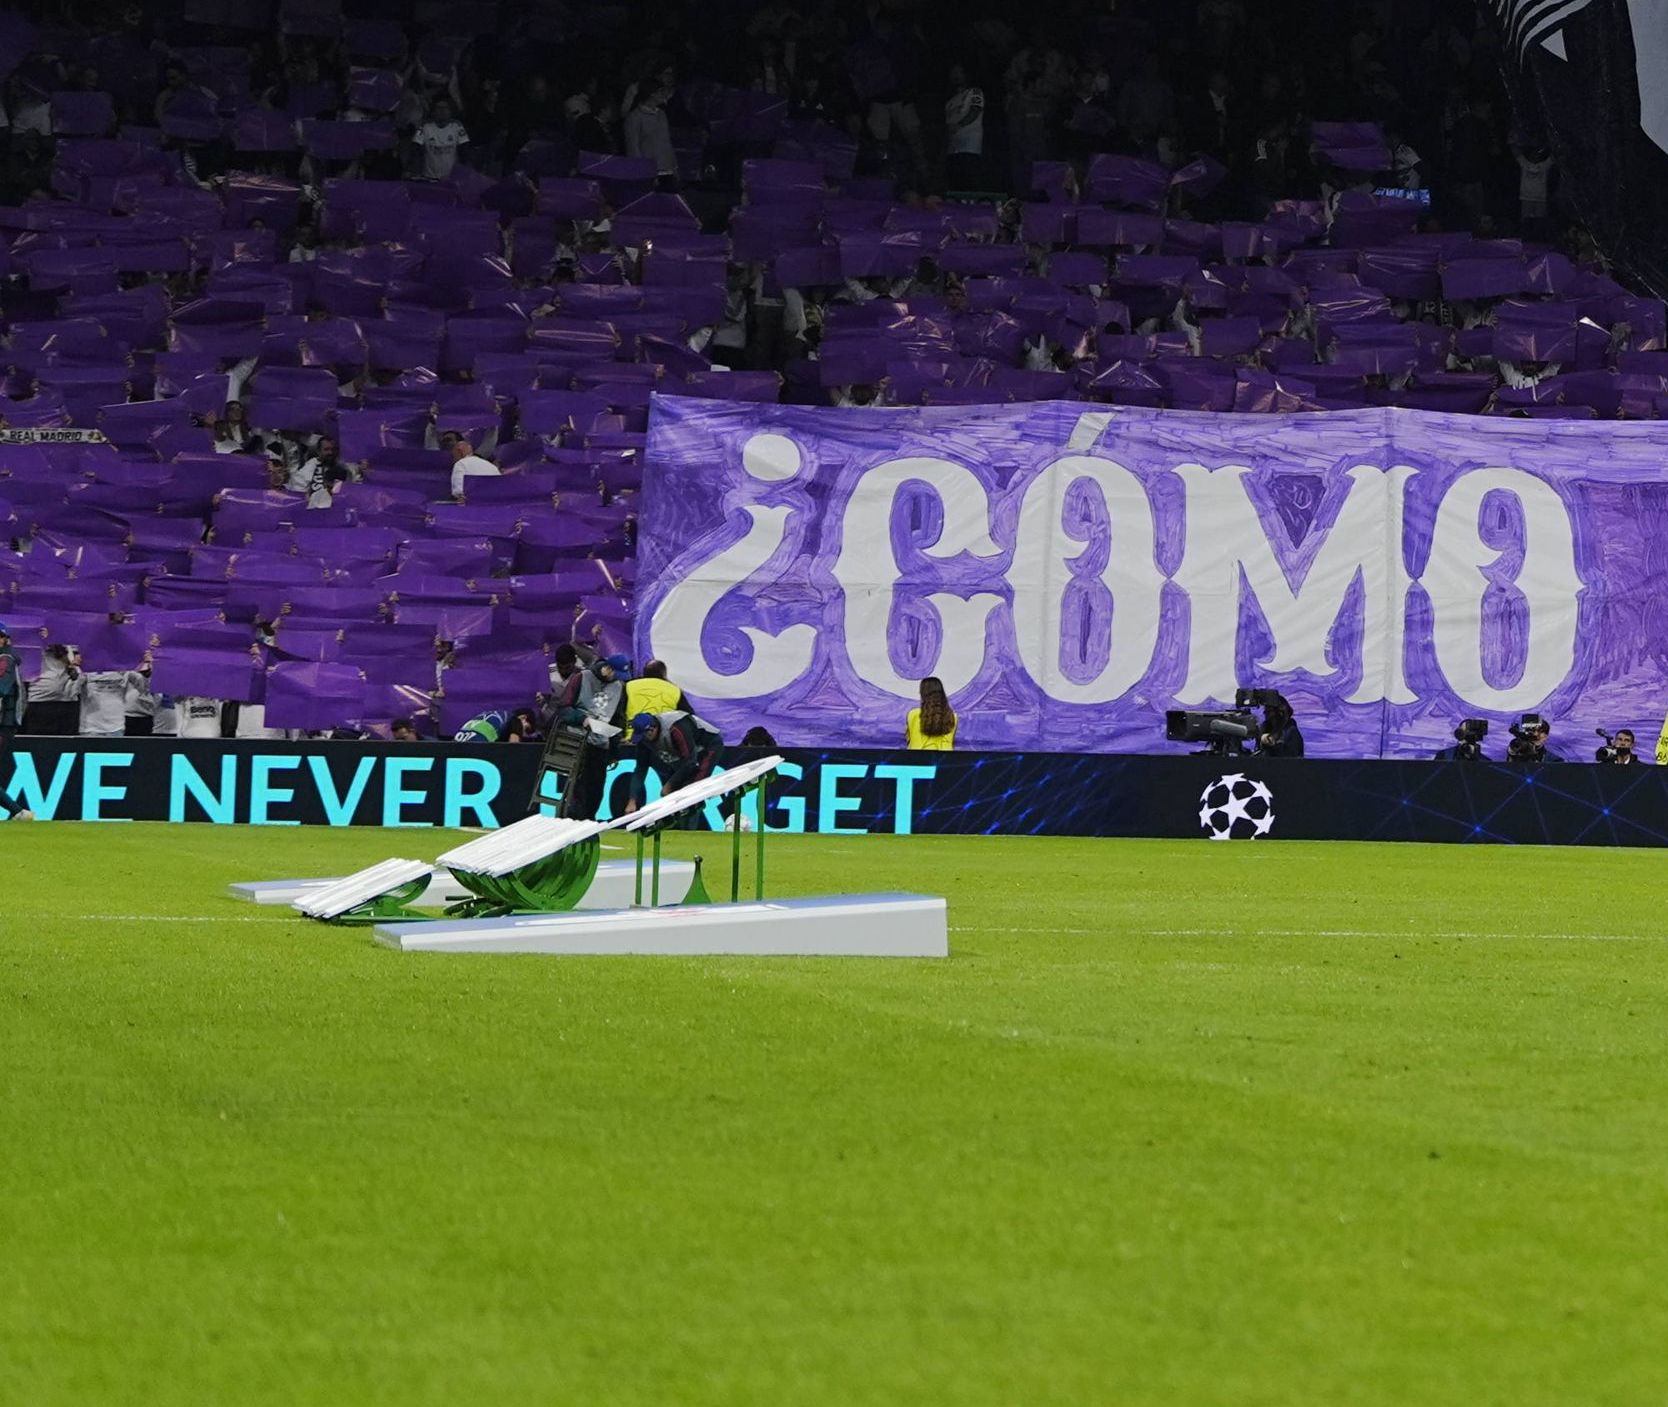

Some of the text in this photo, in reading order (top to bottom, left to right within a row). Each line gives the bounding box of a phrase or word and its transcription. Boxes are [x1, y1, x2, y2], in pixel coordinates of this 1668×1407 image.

[10, 430, 82, 442] REAL MADRID
[649, 411, 1583, 714] ¿CÓMO
[170, 753, 501, 829] NEVER
